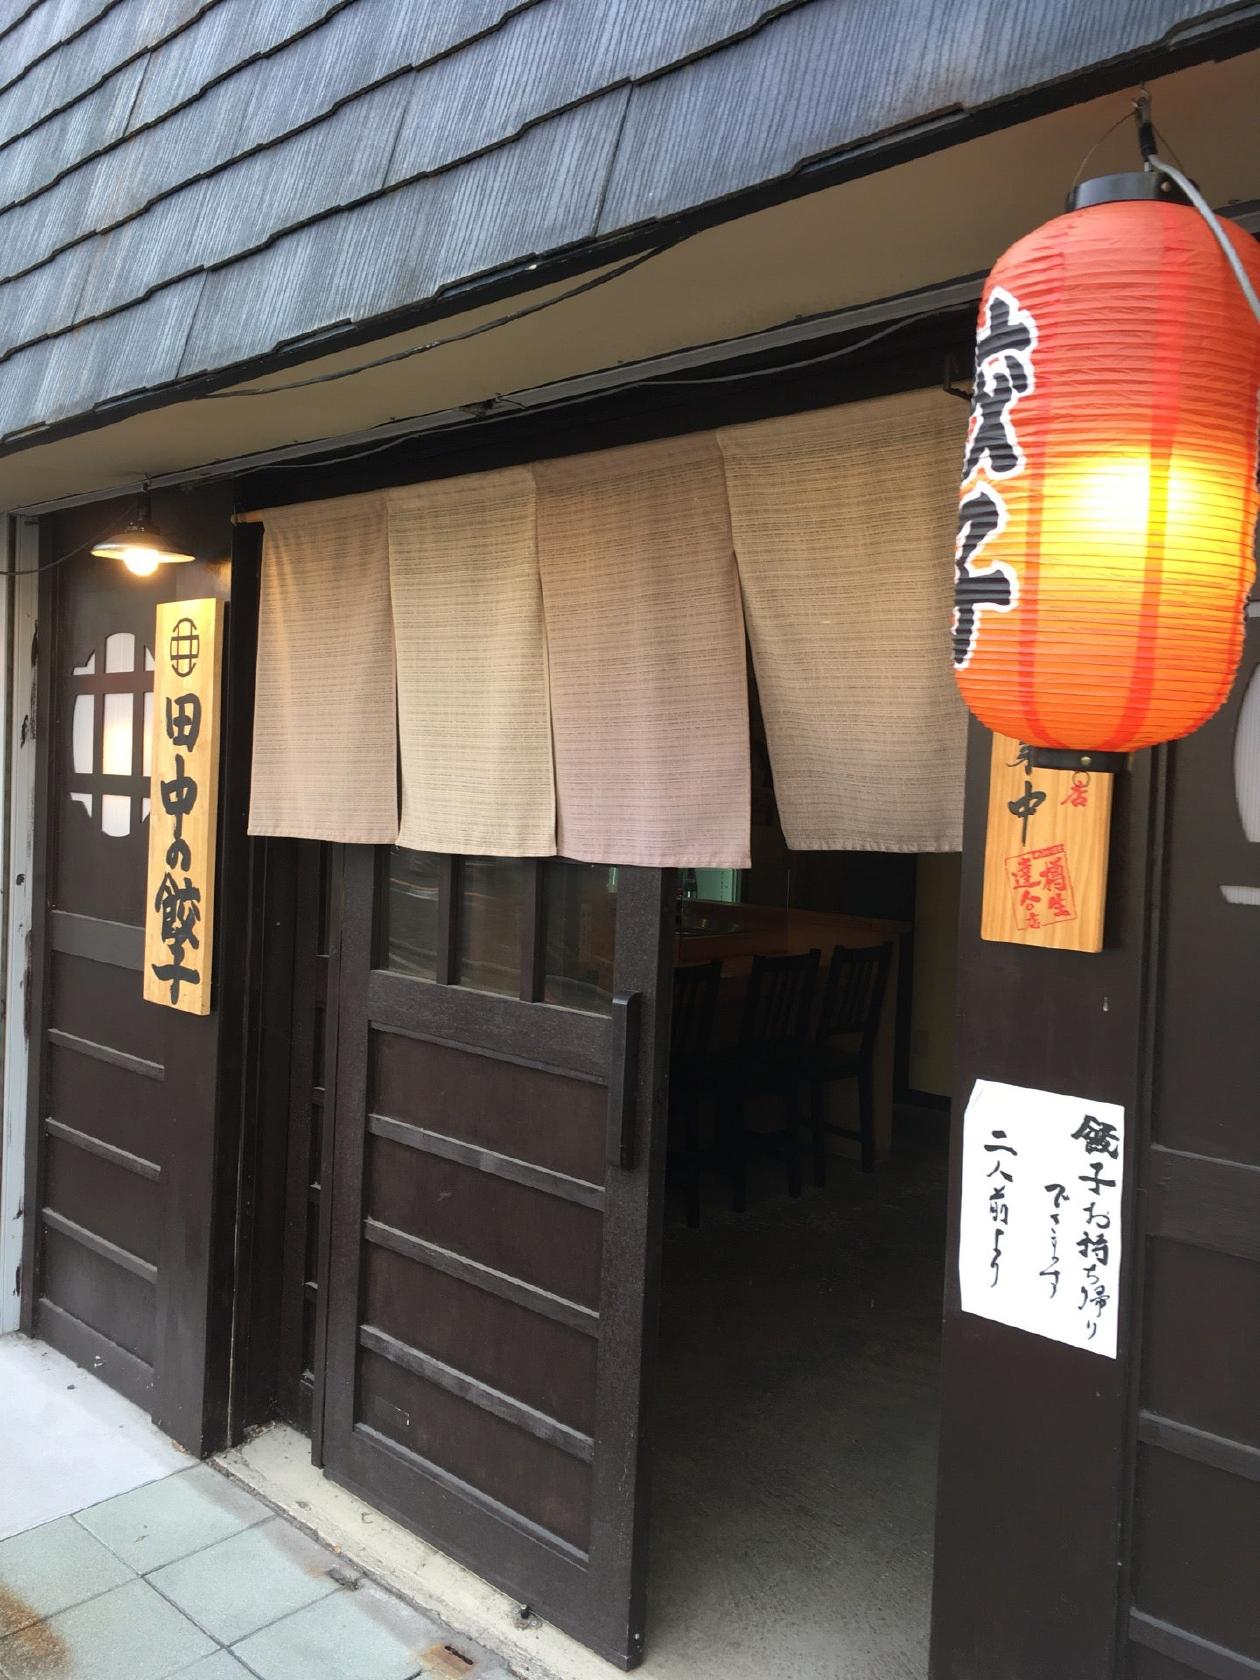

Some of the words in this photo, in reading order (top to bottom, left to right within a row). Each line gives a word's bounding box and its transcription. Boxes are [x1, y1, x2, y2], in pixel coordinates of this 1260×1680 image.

[152, 692, 201, 1005] 田中の餃子
[984, 1130, 1018, 1288] 二人前より
[1071, 1114, 1120, 1340] 餃子お持ち帰り
